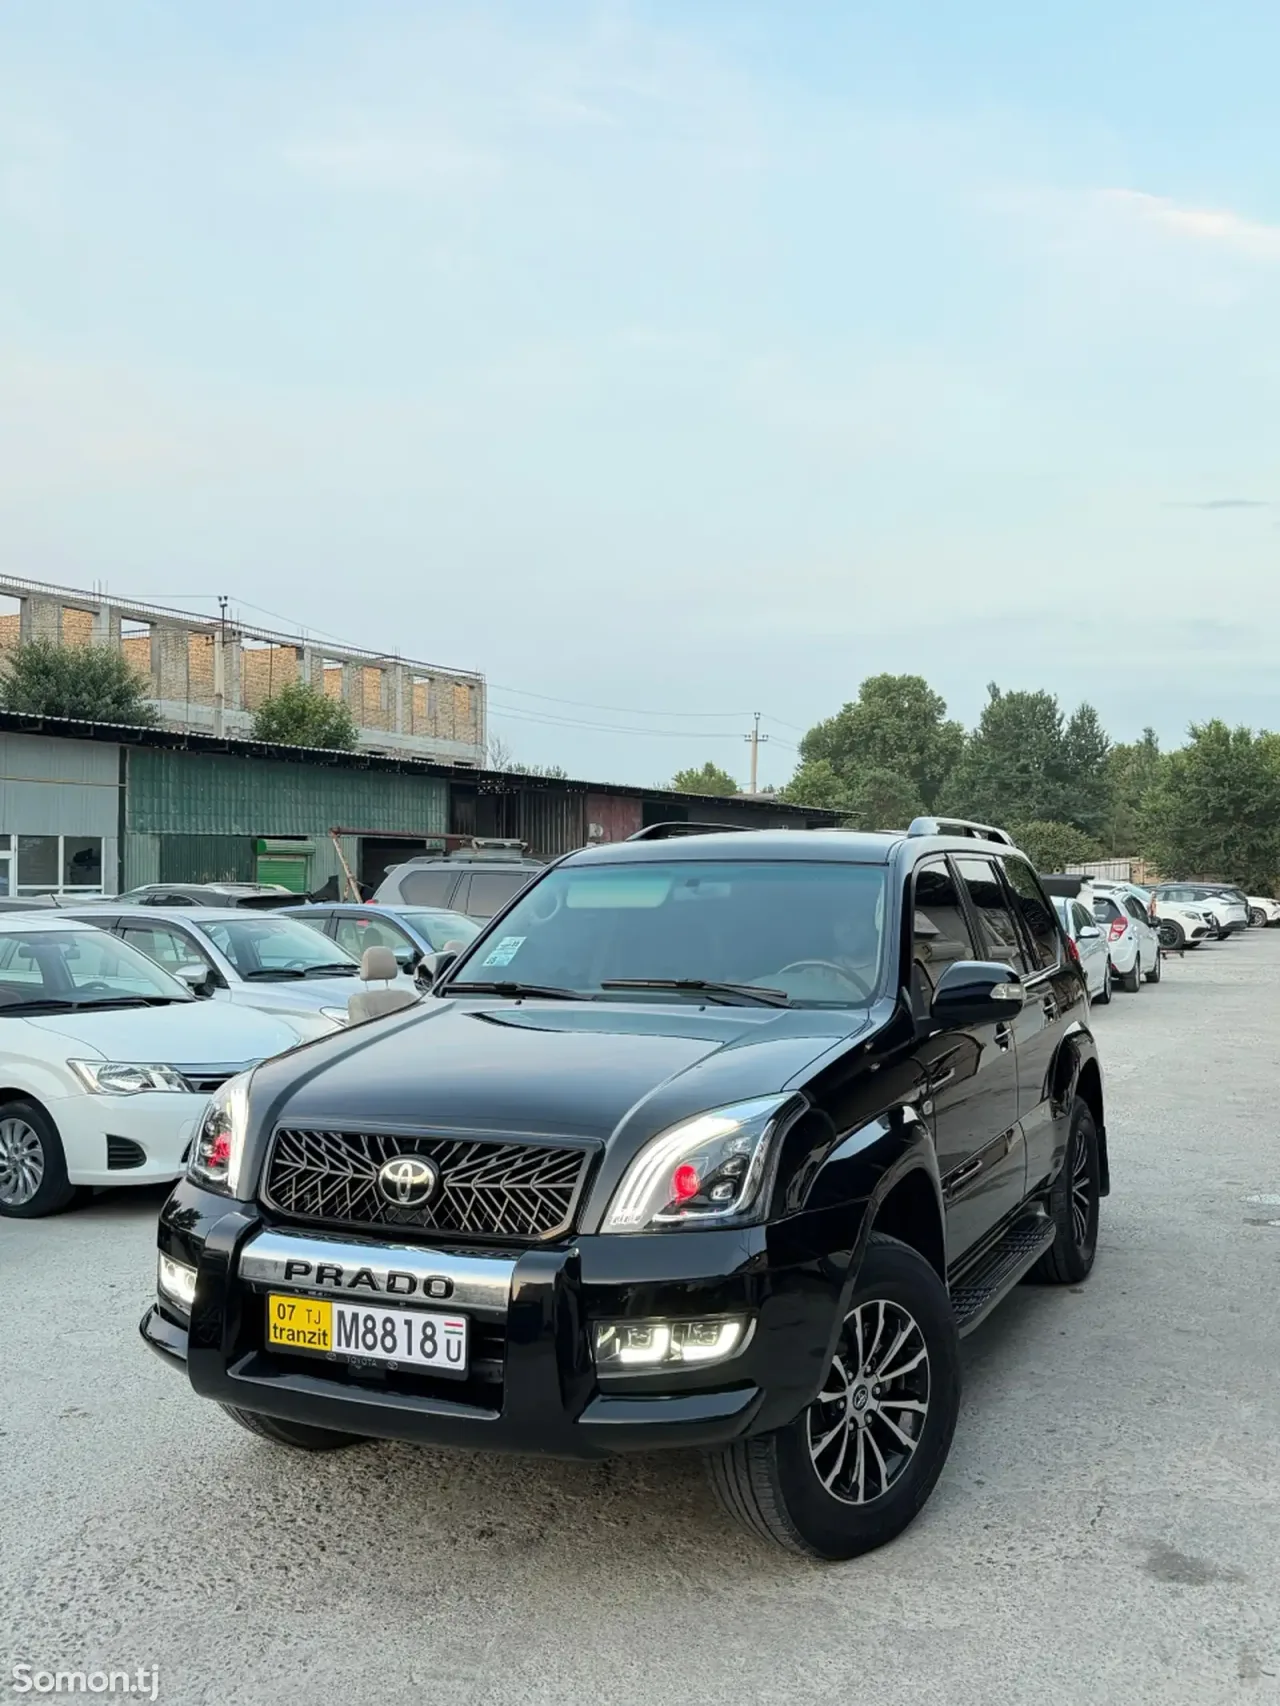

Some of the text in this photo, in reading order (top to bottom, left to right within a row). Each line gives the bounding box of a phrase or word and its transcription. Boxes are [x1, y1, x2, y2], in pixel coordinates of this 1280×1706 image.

[284, 1259, 455, 1299] PRADO
[277, 1303, 321, 1325] 07 TJ
[272, 1323, 329, 1348] tranzit
[336, 1310, 462, 1363] M8818 U
[346, 1355, 378, 1367] TOYOTA
